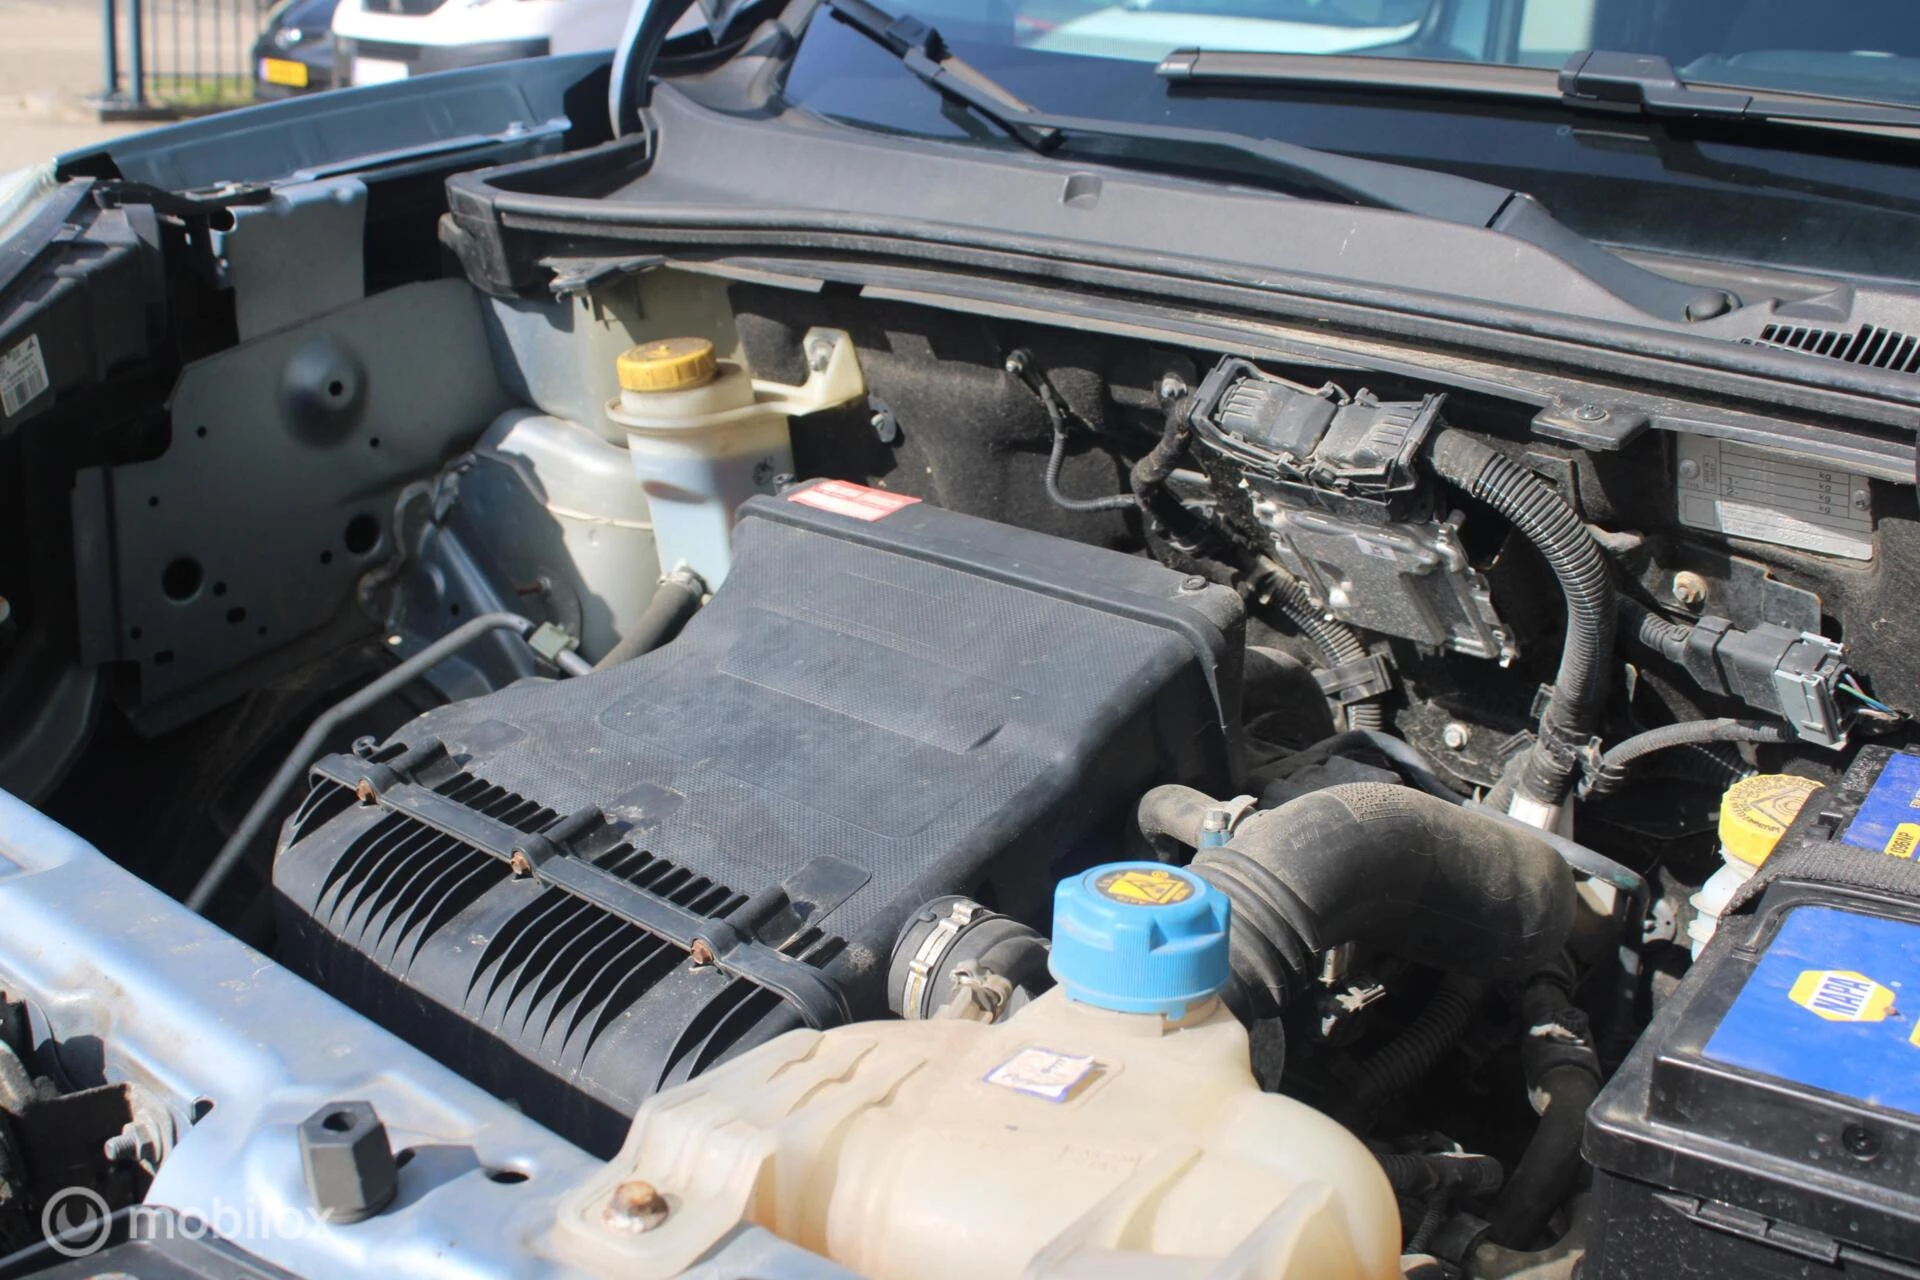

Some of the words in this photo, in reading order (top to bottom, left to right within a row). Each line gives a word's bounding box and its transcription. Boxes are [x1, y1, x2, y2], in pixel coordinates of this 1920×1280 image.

[1819, 484, 1832, 493] kg
[1819, 495, 1832, 504] kg
[1812, 976, 1871, 1016] NAPA
